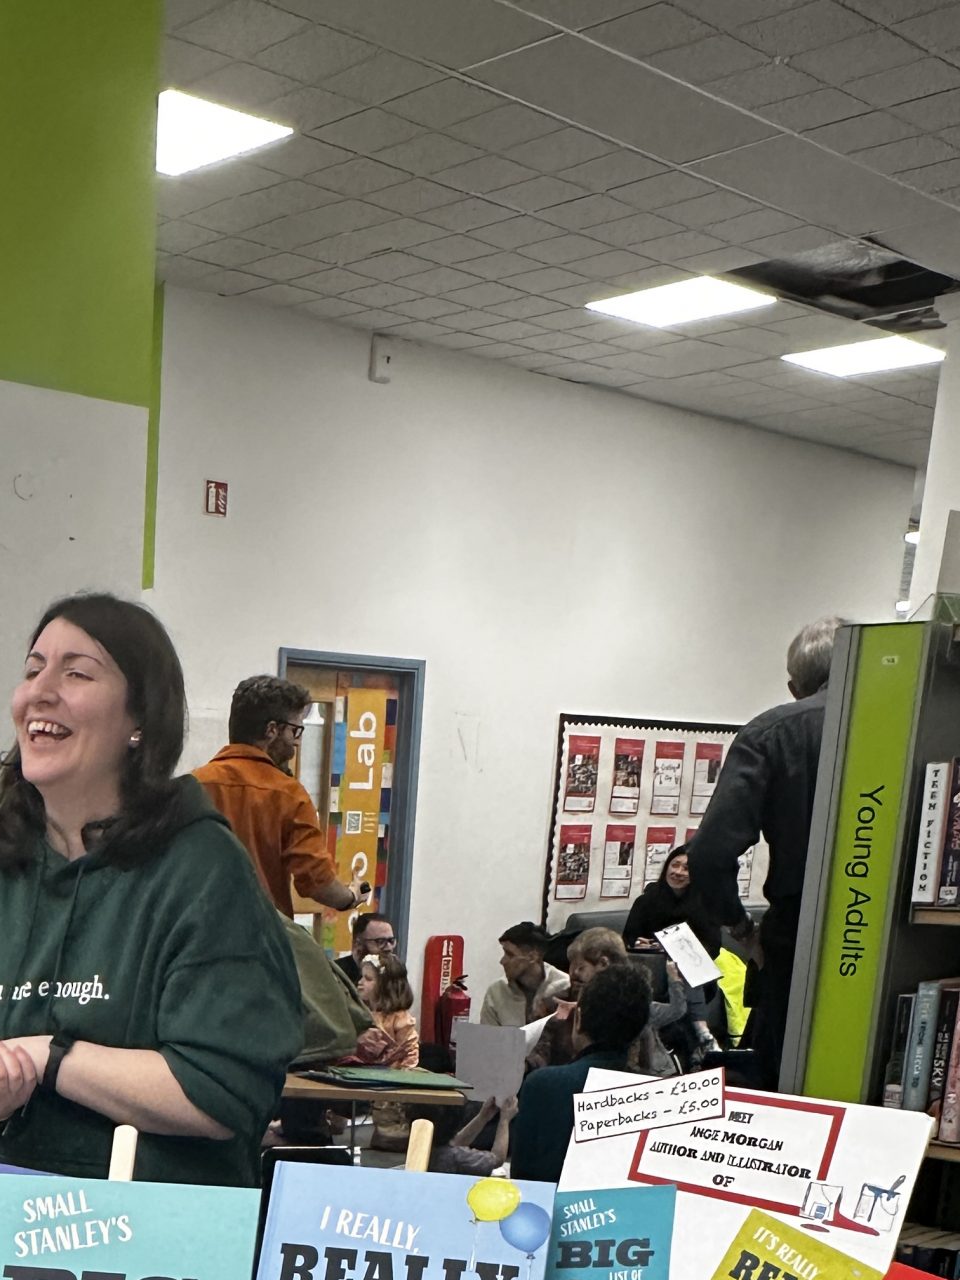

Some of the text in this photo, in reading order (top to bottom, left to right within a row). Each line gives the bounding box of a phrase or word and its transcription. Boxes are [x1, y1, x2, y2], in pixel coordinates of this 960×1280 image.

[349, 711, 377, 790] Lab
[839, 784, 886, 978] Young Adults
[931, 1059, 945, 1087] SKY
[577, 1091, 650, 1112] Hardbacks
[670, 1077, 720, 1096] £10.00
[580, 1109, 657, 1135] Paperbacks
[678, 1098, 719, 1115] £5.00
[728, 1111, 754, 1124] MEET
[690, 1126, 784, 1151] ANGIE MORGAN
[650, 1141, 812, 1179] AUTHOR AND ILLUSTRATOR
[712, 1174, 735, 1188] OF
[23, 1189, 93, 1223] SMALL
[563, 1197, 597, 1220] SMALL
[14, 1215, 133, 1257] STANLEY'S
[320, 1206, 421, 1253] I REALLY,
[560, 1208, 617, 1238] STANLEY'S
[752, 1226, 776, 1251] IT'S
[556, 1238, 655, 1269] BIG
